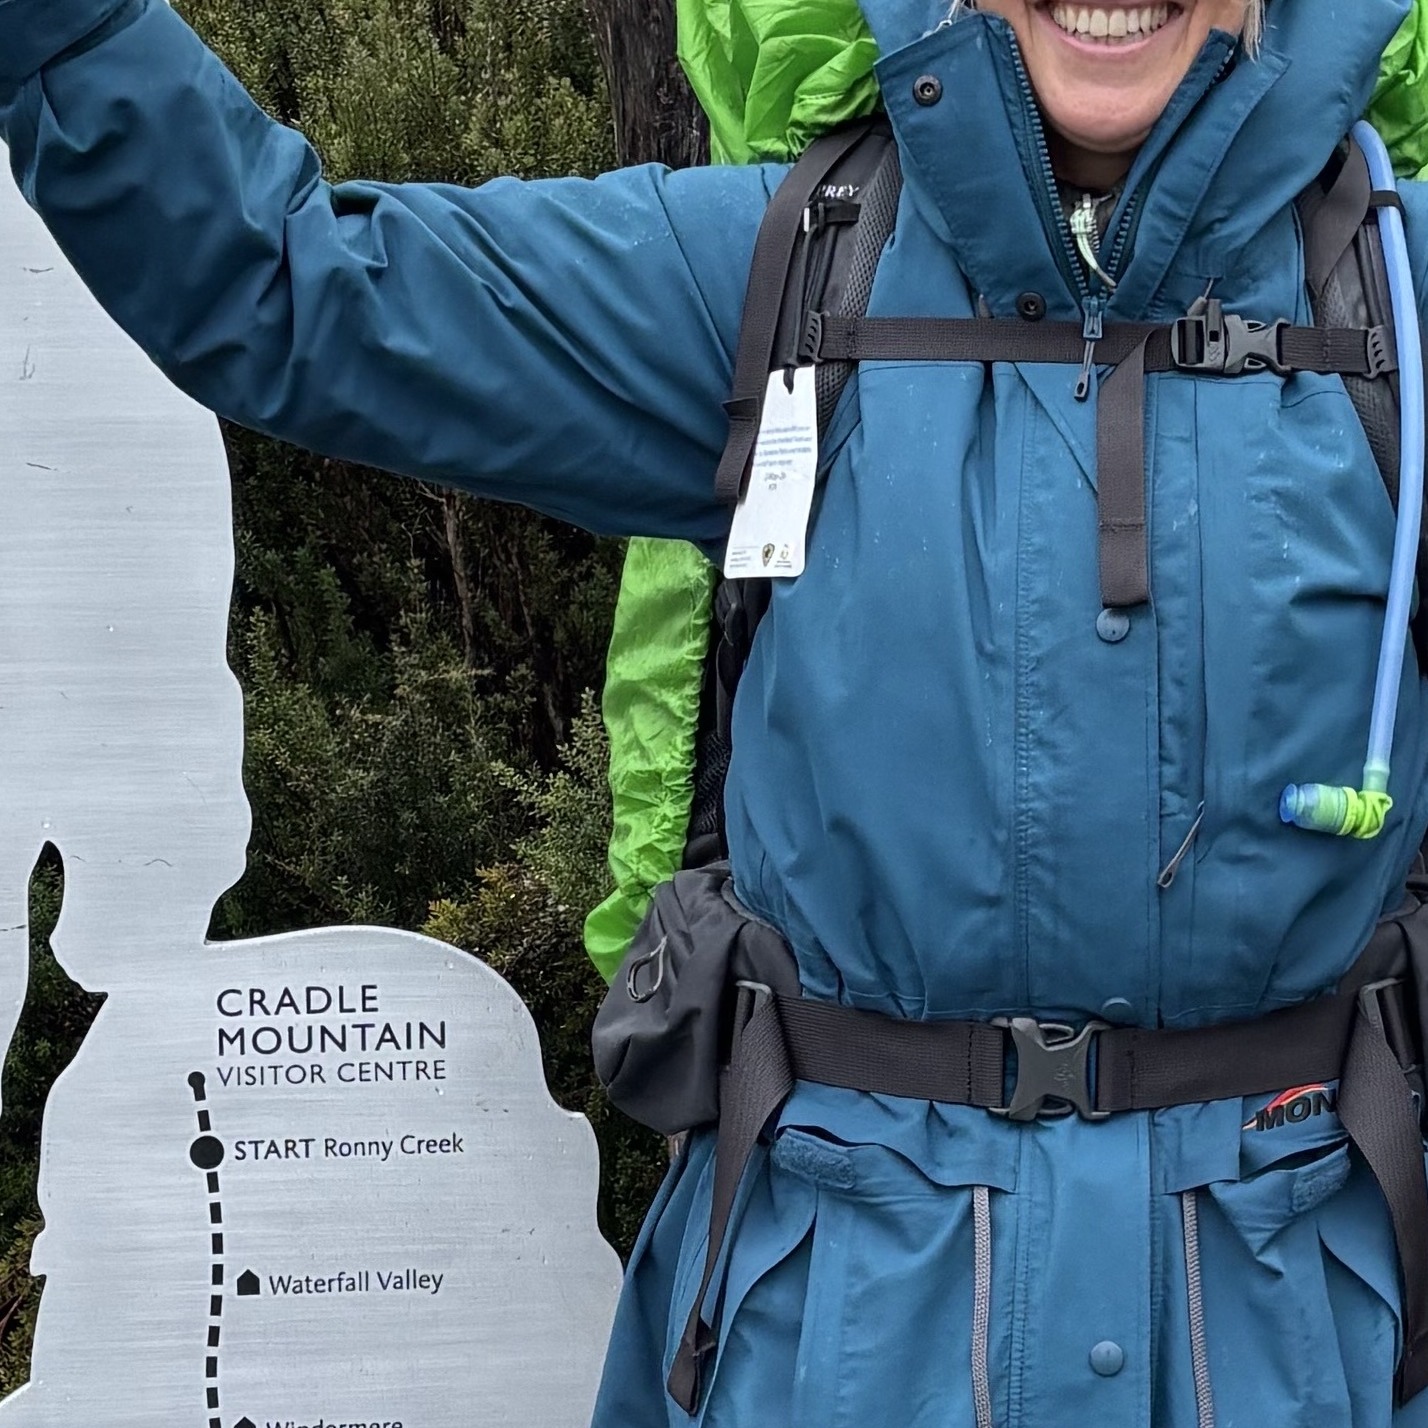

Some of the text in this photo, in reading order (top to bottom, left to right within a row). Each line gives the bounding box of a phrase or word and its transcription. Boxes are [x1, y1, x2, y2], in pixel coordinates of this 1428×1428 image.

[216, 984, 379, 1017] CRADLE
[218, 1020, 446, 1057] MOUNTAIN
[216, 1059, 447, 1087] VISITOR CENTRE
[1255, 1088, 1337, 1132] MON
[234, 1132, 464, 1162] START Ronny Creek
[268, 1268, 444, 1296] Waterfall Valley
